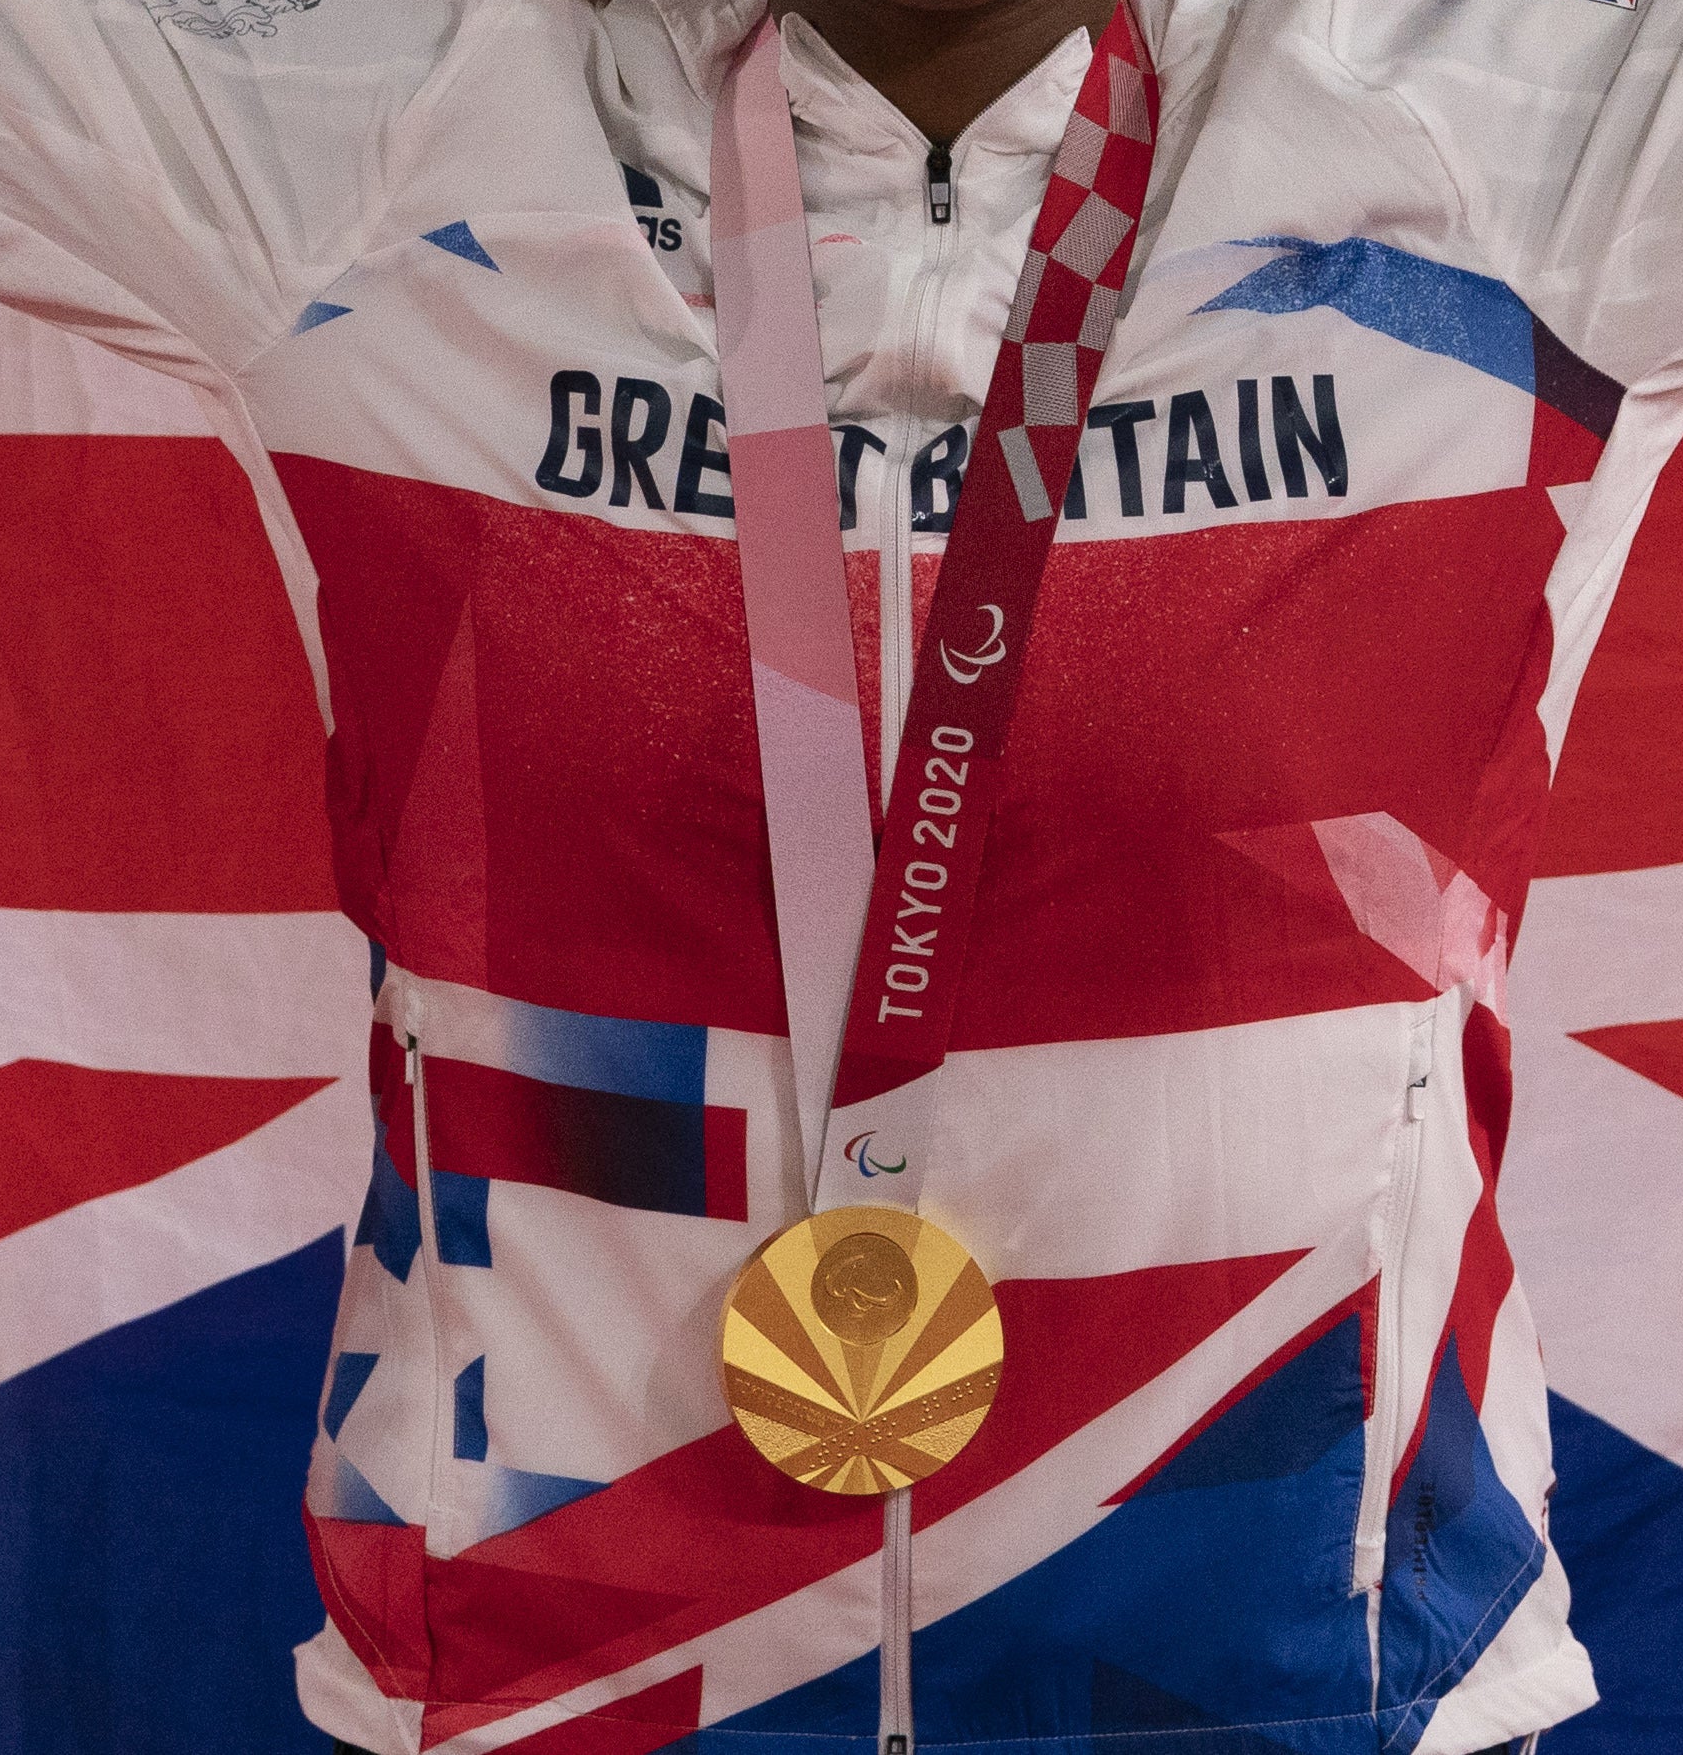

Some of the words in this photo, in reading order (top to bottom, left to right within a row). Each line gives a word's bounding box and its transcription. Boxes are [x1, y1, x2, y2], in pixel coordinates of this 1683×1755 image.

[535, 370, 887, 531] GRET
[912, 726, 974, 849] 2020
[877, 861, 948, 1024] TOKYO
